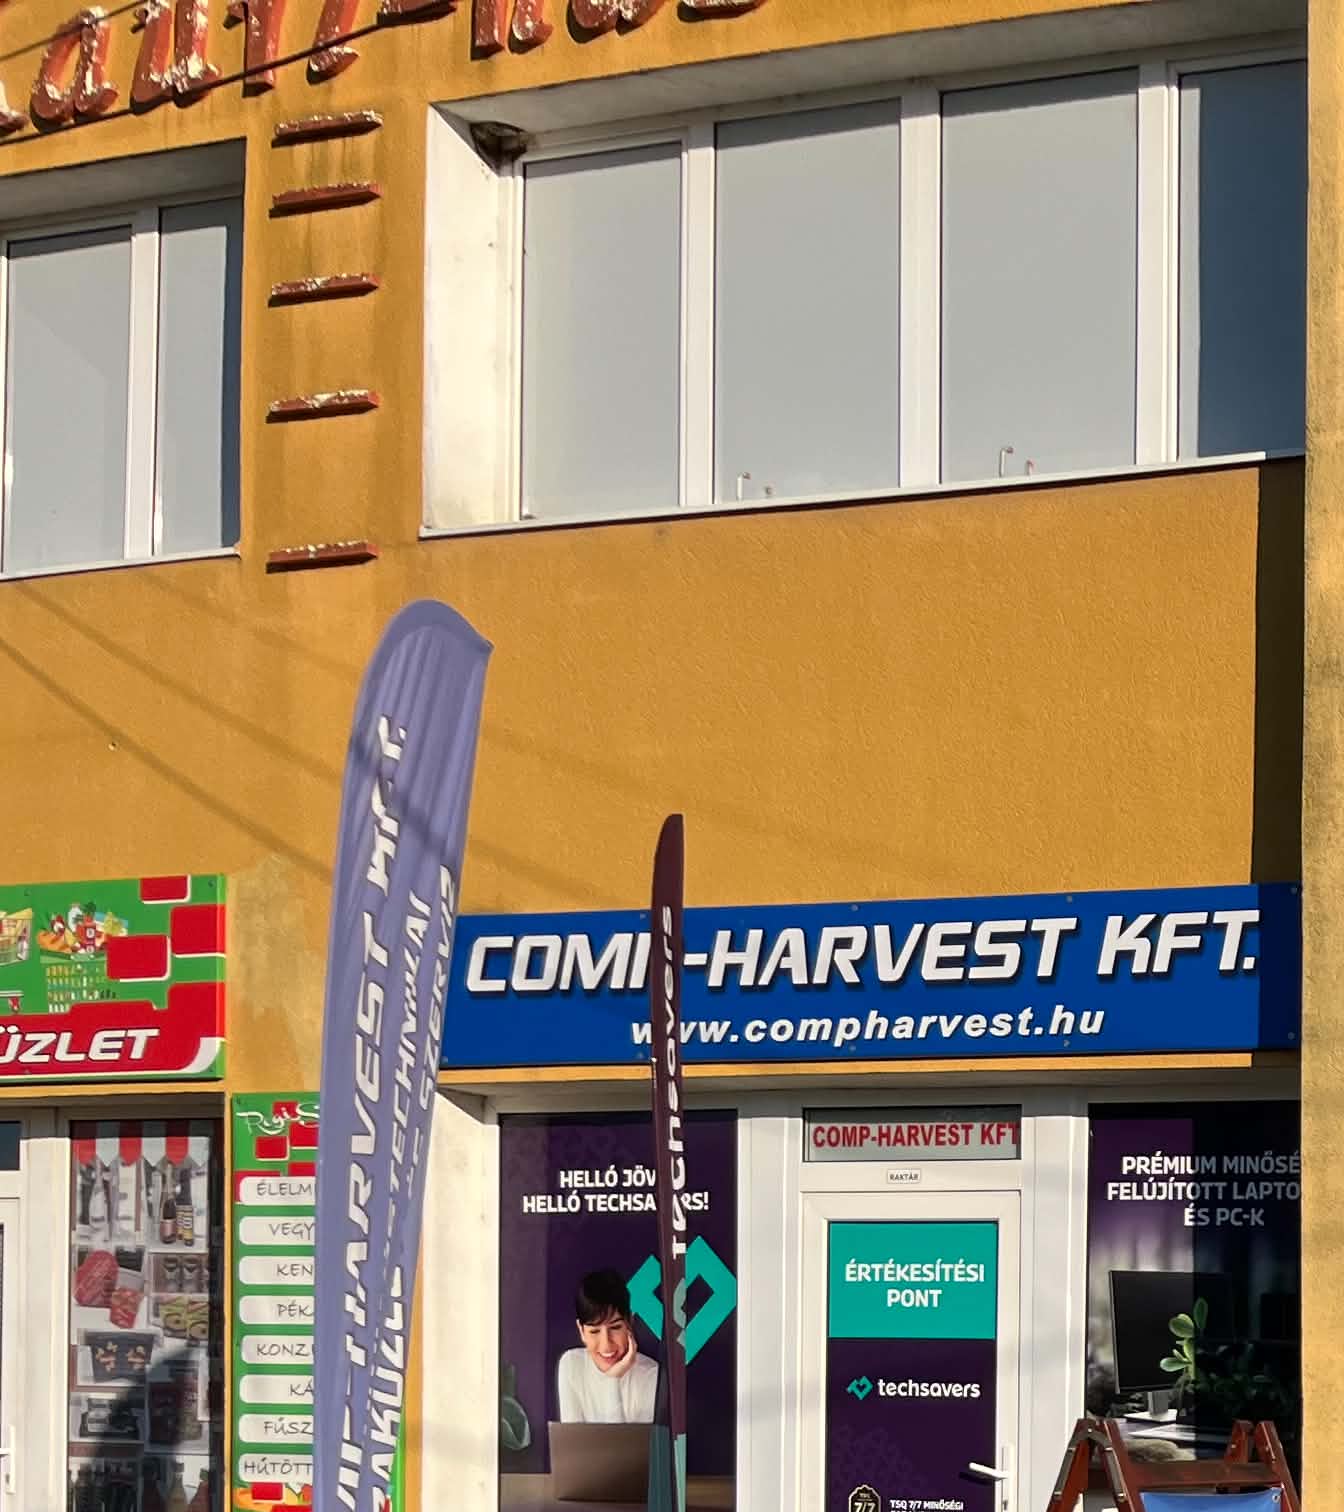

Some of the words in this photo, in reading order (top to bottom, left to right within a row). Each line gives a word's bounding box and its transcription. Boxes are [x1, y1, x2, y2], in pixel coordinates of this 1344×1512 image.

[1097, 909, 1260, 977] KFT.
[813, 1122, 973, 1147] COMP-HARVEST
[1122, 1151, 1216, 1175] PRÉMIUM
[1223, 1151, 1300, 1174] MINŐSÉ
[559, 1164, 618, 1188] HELLÓ
[622, 1164, 656, 1187] JÖV
[889, 1172, 919, 1181] RAKTÁR
[256, 1178, 316, 1197] ÉLELM
[1107, 1177, 1227, 1200] FELÚJÍTOTT
[1233, 1182, 1300, 1199] LAPTO
[523, 1188, 581, 1212] HELLÓ
[584, 1191, 709, 1212] TECHSARS!
[1184, 1203, 1209, 1226] ÉS
[1216, 1208, 1264, 1226] PC-K
[269, 1223, 315, 1240] VEGY
[276, 1264, 313, 1277] KEN
[845, 1258, 984, 1283] ÉRTÉKESÍTÉSI
[887, 1290, 942, 1309] PONT
[277, 1302, 314, 1317] PÉK
[256, 1343, 314, 1357] KONZ
[290, 1382, 314, 1396] KÁ
[878, 1379, 981, 1398] techsavers
[909, 1500, 922, 1511] 7/7
